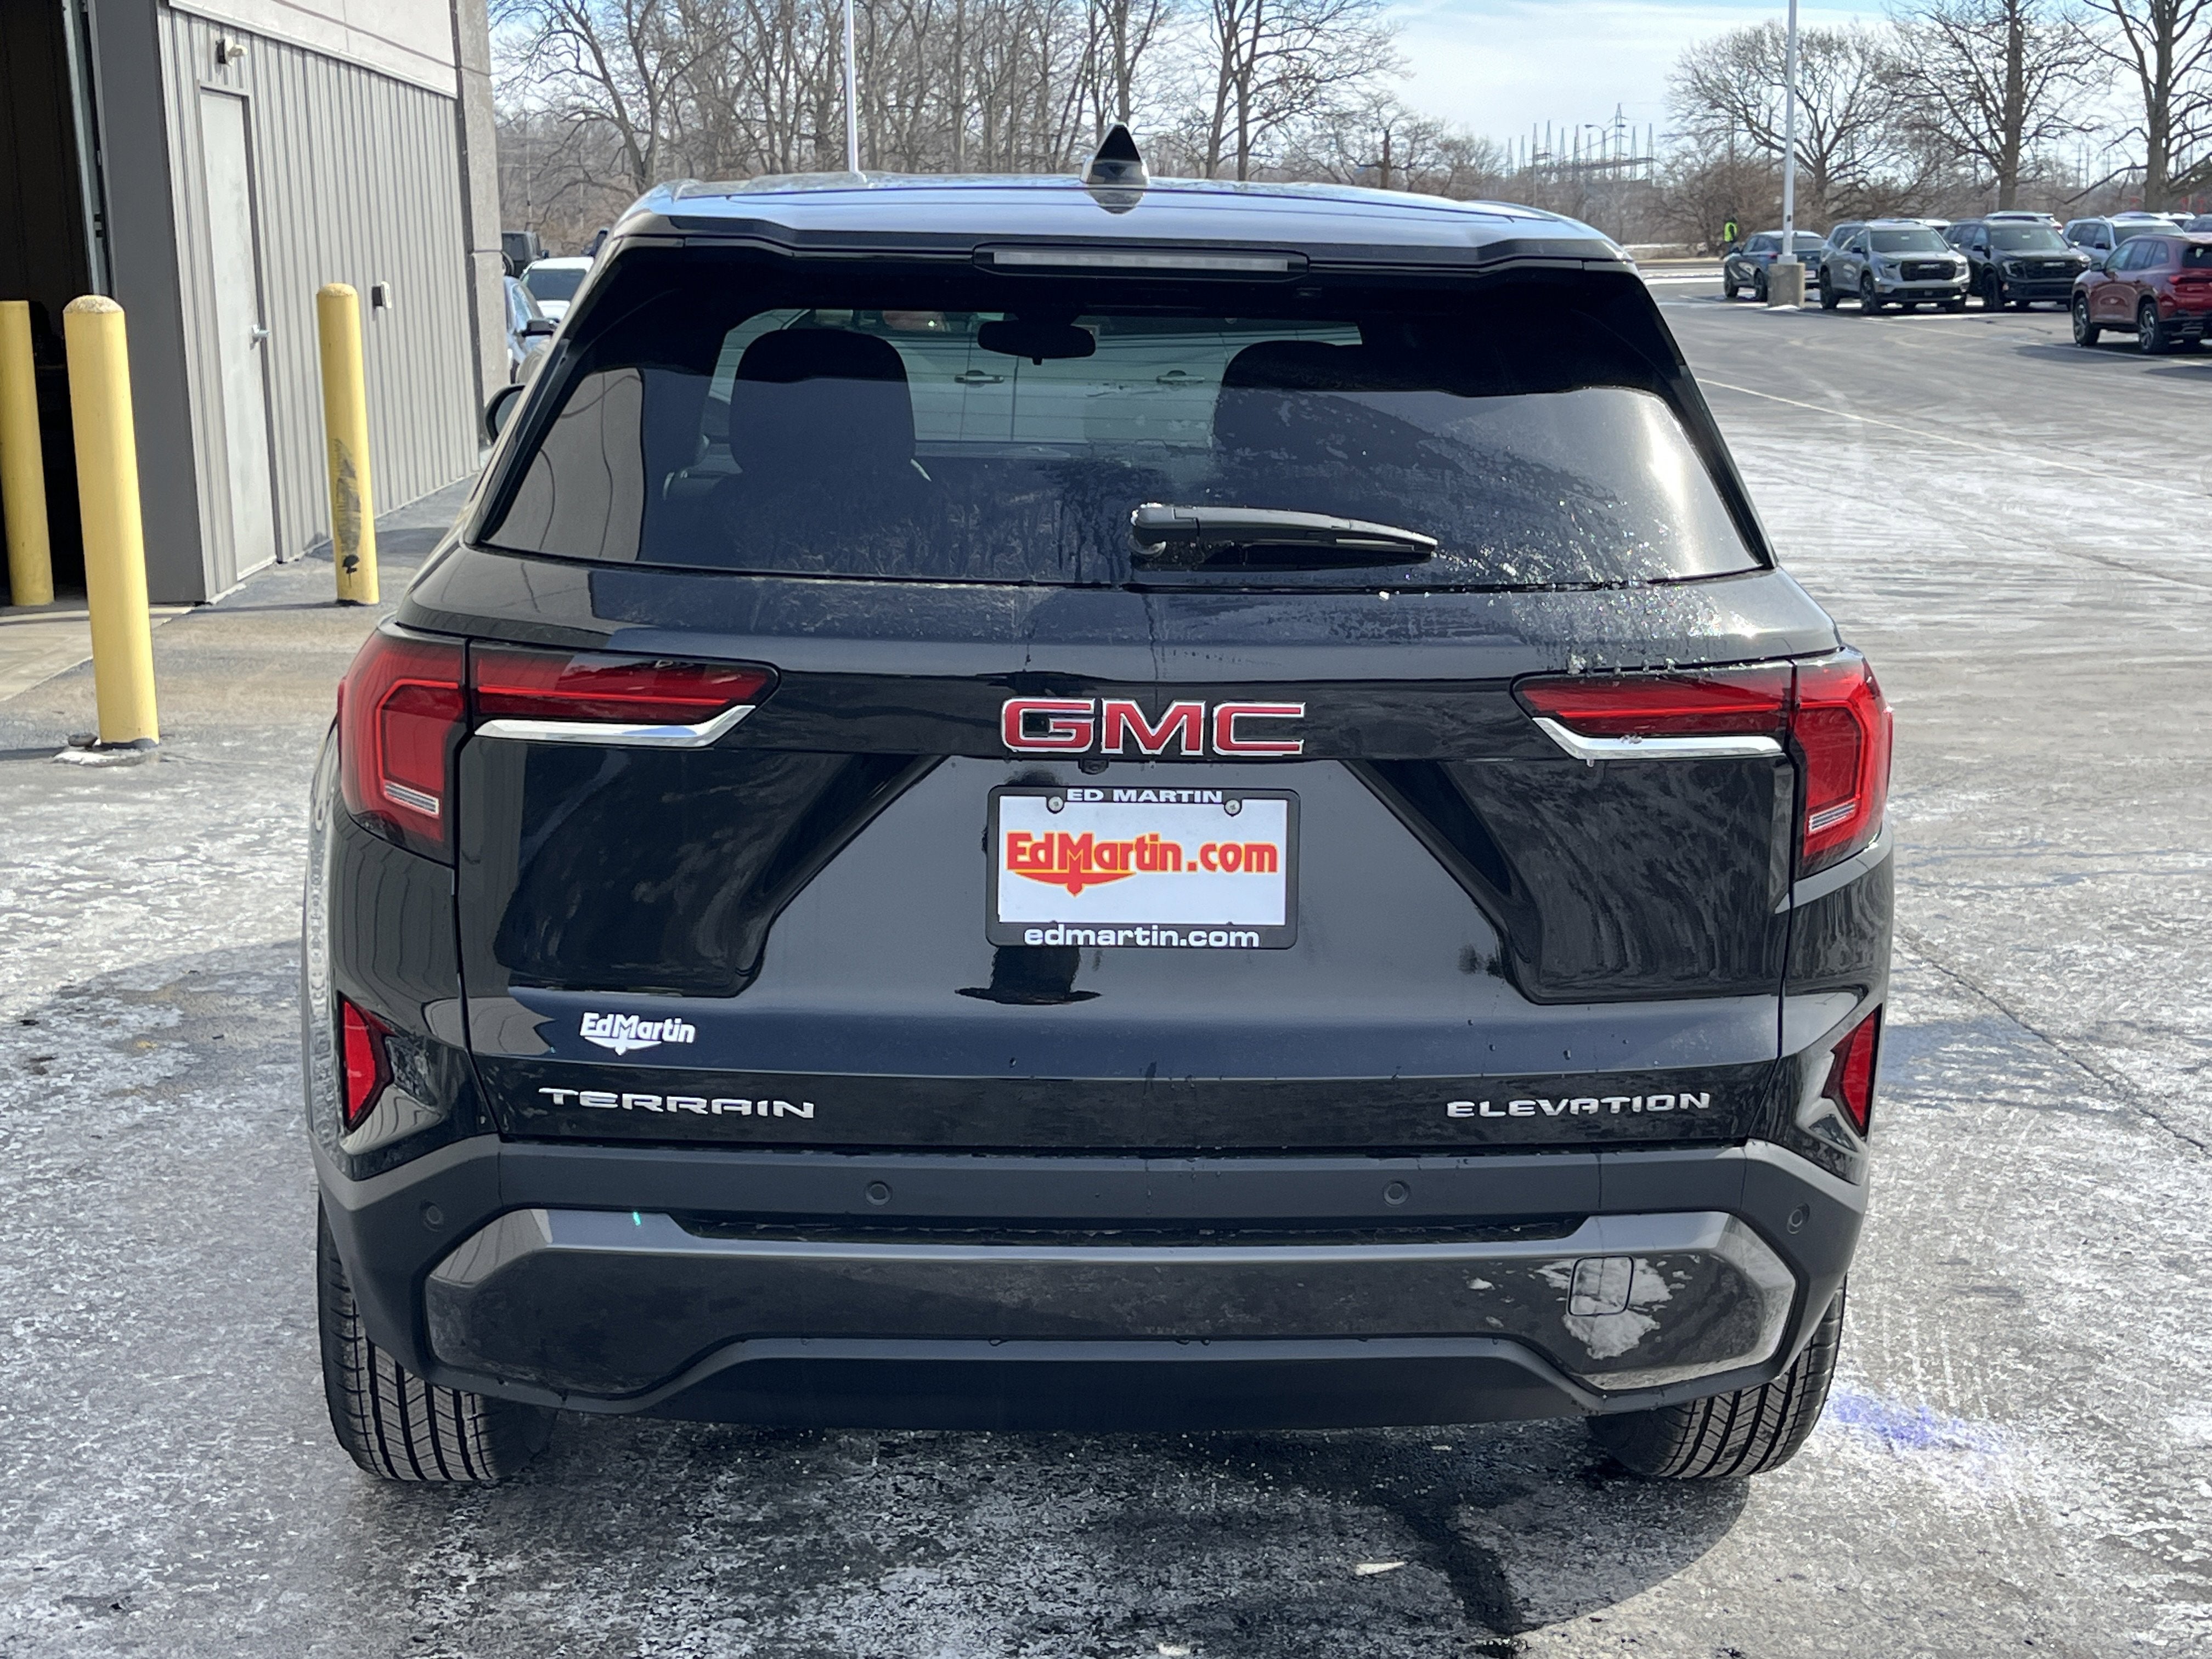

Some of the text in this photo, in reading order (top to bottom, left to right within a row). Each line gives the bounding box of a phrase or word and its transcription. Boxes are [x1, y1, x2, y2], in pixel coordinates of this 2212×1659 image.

[1001, 697, 1306, 756] GMC
[1066, 788, 1223, 803] ED MARTIN
[1006, 831, 1278, 874] EdMartin.com
[1024, 924, 1260, 947] edmartin.com
[580, 1012, 695, 1043] EdMartin
[539, 1087, 814, 1118] TERRAIN
[1447, 1092, 1711, 1118] ELEVATION
